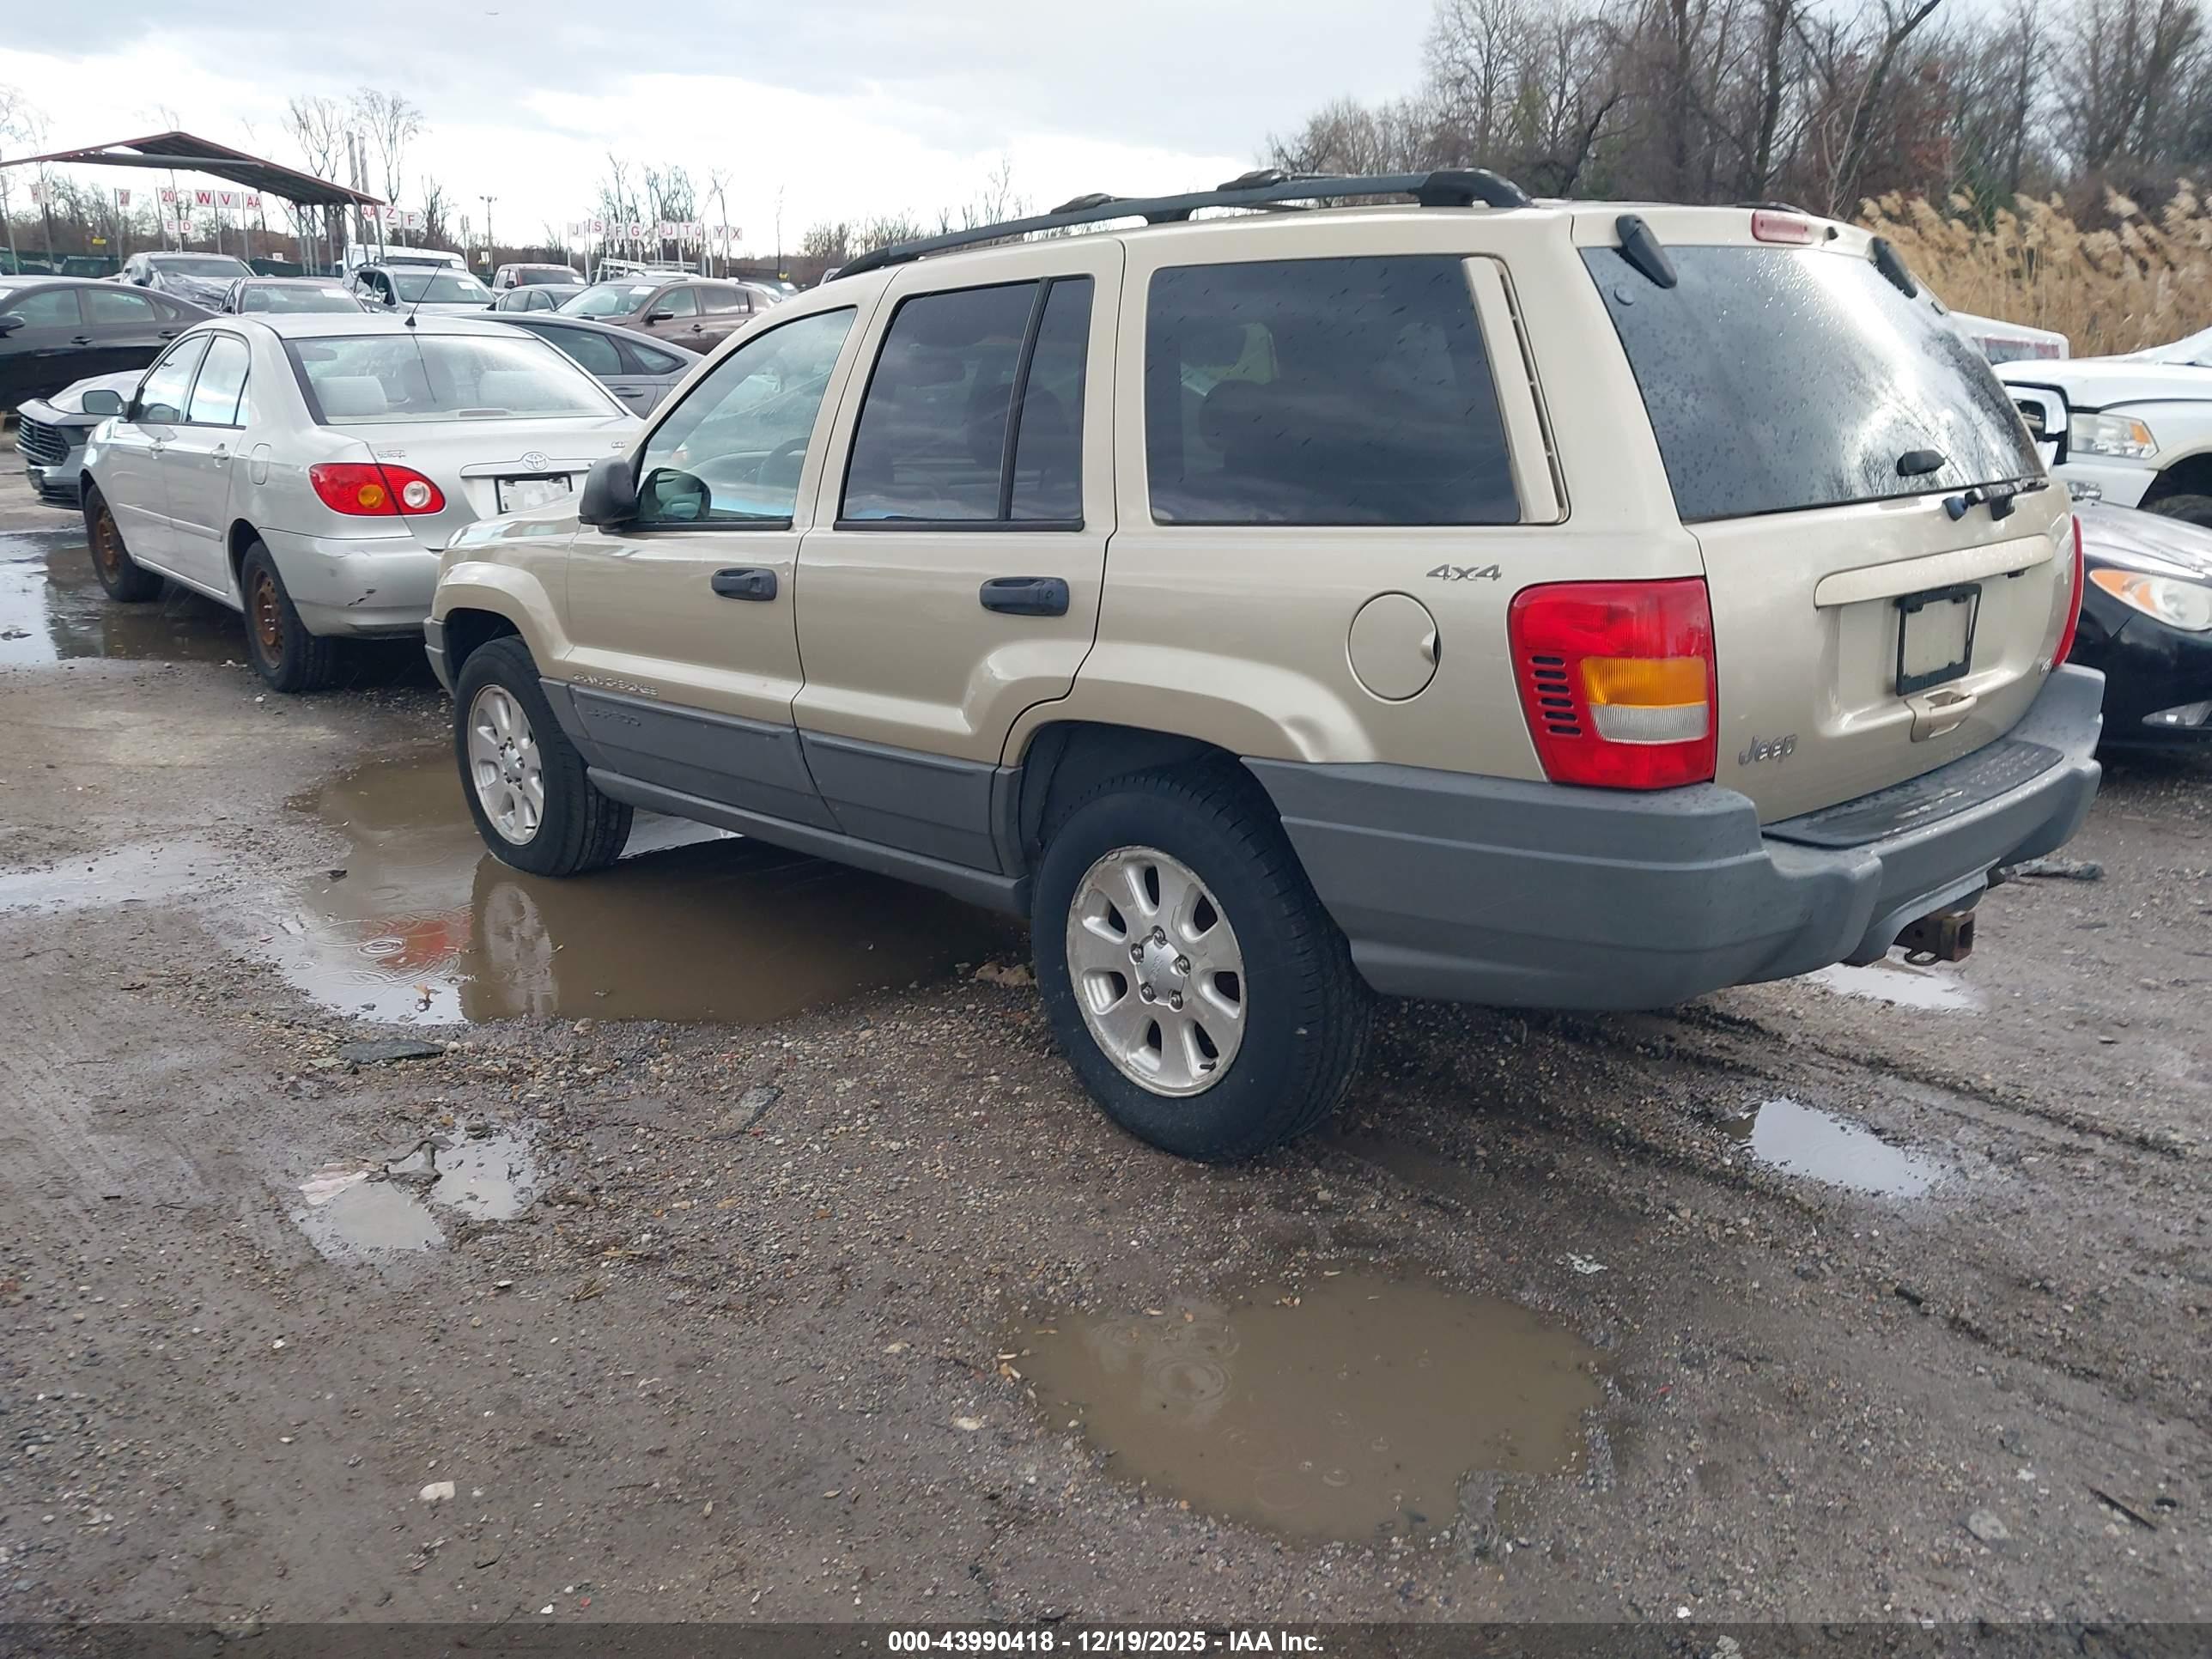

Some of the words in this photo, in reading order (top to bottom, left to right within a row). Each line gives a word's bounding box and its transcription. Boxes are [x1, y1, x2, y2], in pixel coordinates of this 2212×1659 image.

[161, 189, 175, 203] 20
[196, 191, 211, 204] W
[221, 192, 231, 205] V
[246, 196, 261, 207] AA
[386, 208, 395, 220] Z
[167, 221, 173, 230] E
[183, 222, 191, 231] D
[407, 215, 415, 227] F
[594, 221, 602, 232] S
[573, 225, 579, 235] J
[616, 226, 623, 236] F
[631, 226, 640, 237] G
[683, 225, 690, 235] T
[716, 227, 724, 237] Y
[733, 228, 741, 239] X
[1737, 733, 1797, 766] Jeep
